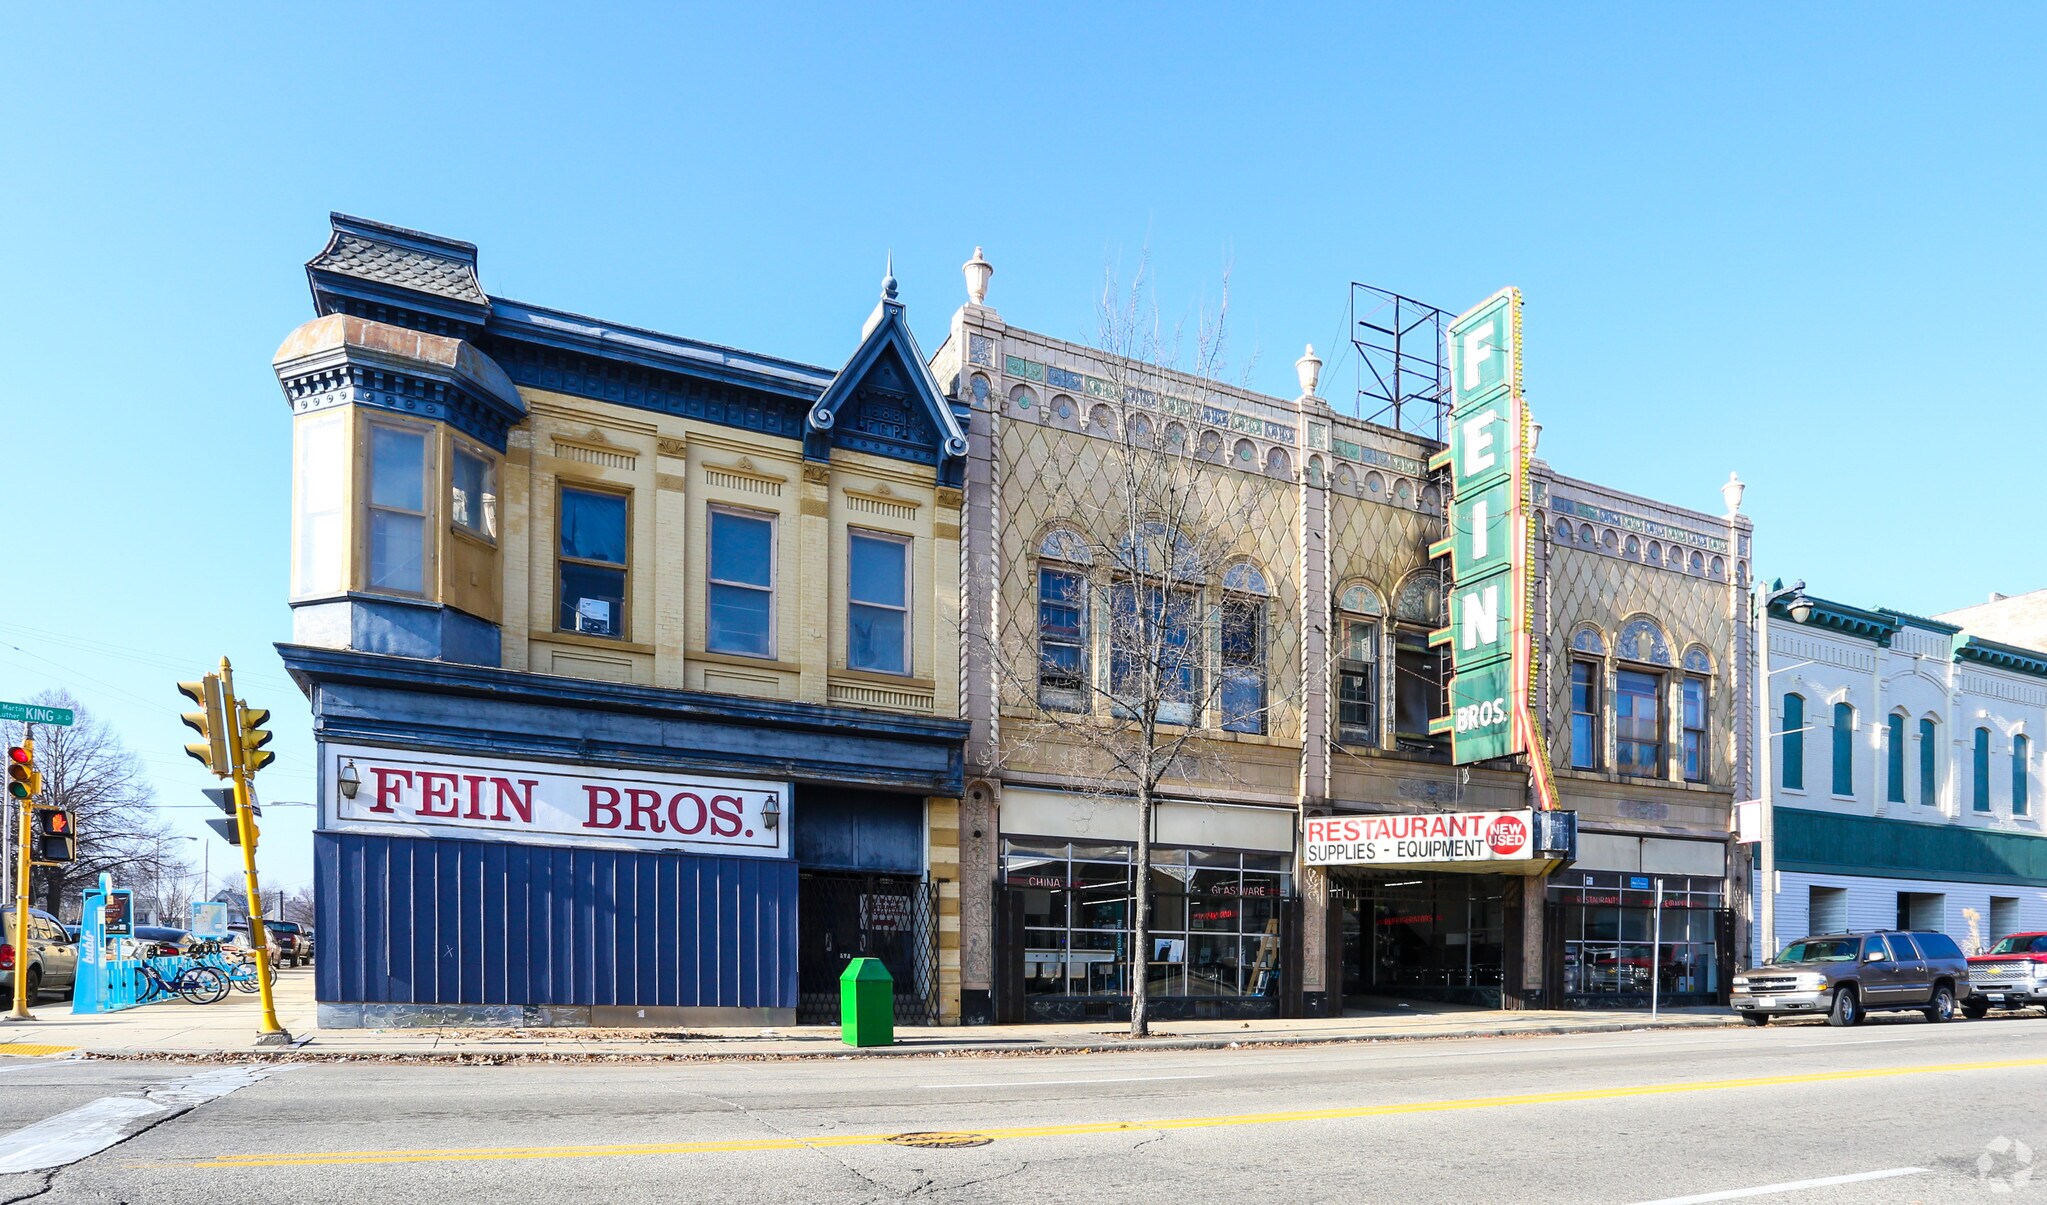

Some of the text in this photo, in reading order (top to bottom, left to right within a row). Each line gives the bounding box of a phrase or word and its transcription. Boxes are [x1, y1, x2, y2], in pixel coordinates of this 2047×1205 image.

[1463, 320, 1498, 651] FEIN
[2, 704, 25, 712] Martin
[25, 707, 54, 721] KING
[1456, 698, 1507, 733] BROS.
[369, 767, 754, 838] FEIN BROS.
[1308, 815, 1485, 842] RESTAURANT
[1489, 822, 1523, 836] NEW
[1487, 834, 1526, 847] USED
[1308, 842, 1376, 862] SUPPLIES
[1397, 839, 1485, 858] EQUIPMENT
[1028, 877, 1061, 887] CHINA
